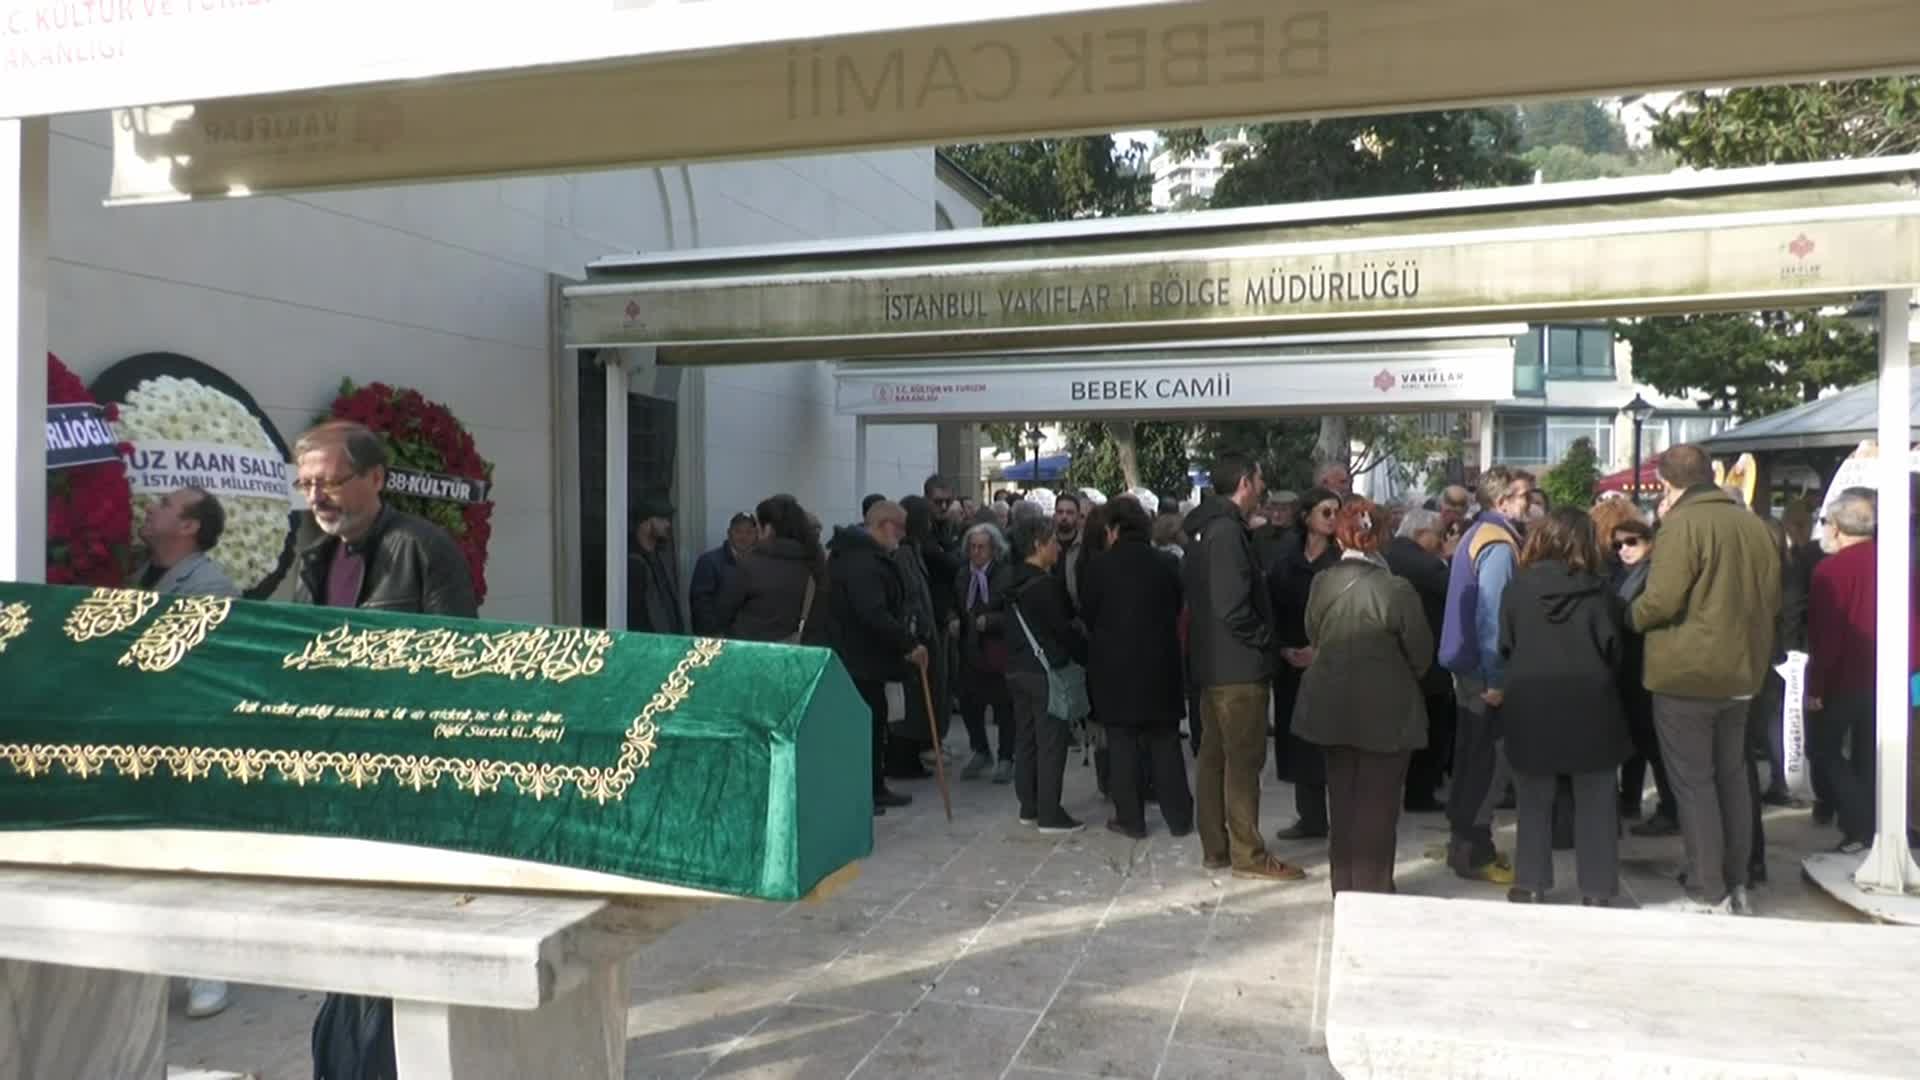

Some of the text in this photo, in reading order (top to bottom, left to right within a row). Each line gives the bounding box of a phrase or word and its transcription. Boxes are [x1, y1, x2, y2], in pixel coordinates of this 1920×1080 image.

[884, 287, 988, 321] İSTANBUL
[999, 284, 1111, 317] VAKIFLAR
[1151, 272, 1230, 306] BÖLGE
[1245, 260, 1419, 305] MÜDÜRLÜĞÜ
[1401, 372, 1464, 383] VAKIFLAR
[1071, 379, 1148, 400] BEBEK
[47, 411, 119, 450] RLİOĞLU
[130, 450, 168, 471] UZ
[175, 451, 236, 473] KAAN
[143, 473, 217, 489] İSTANBUL
